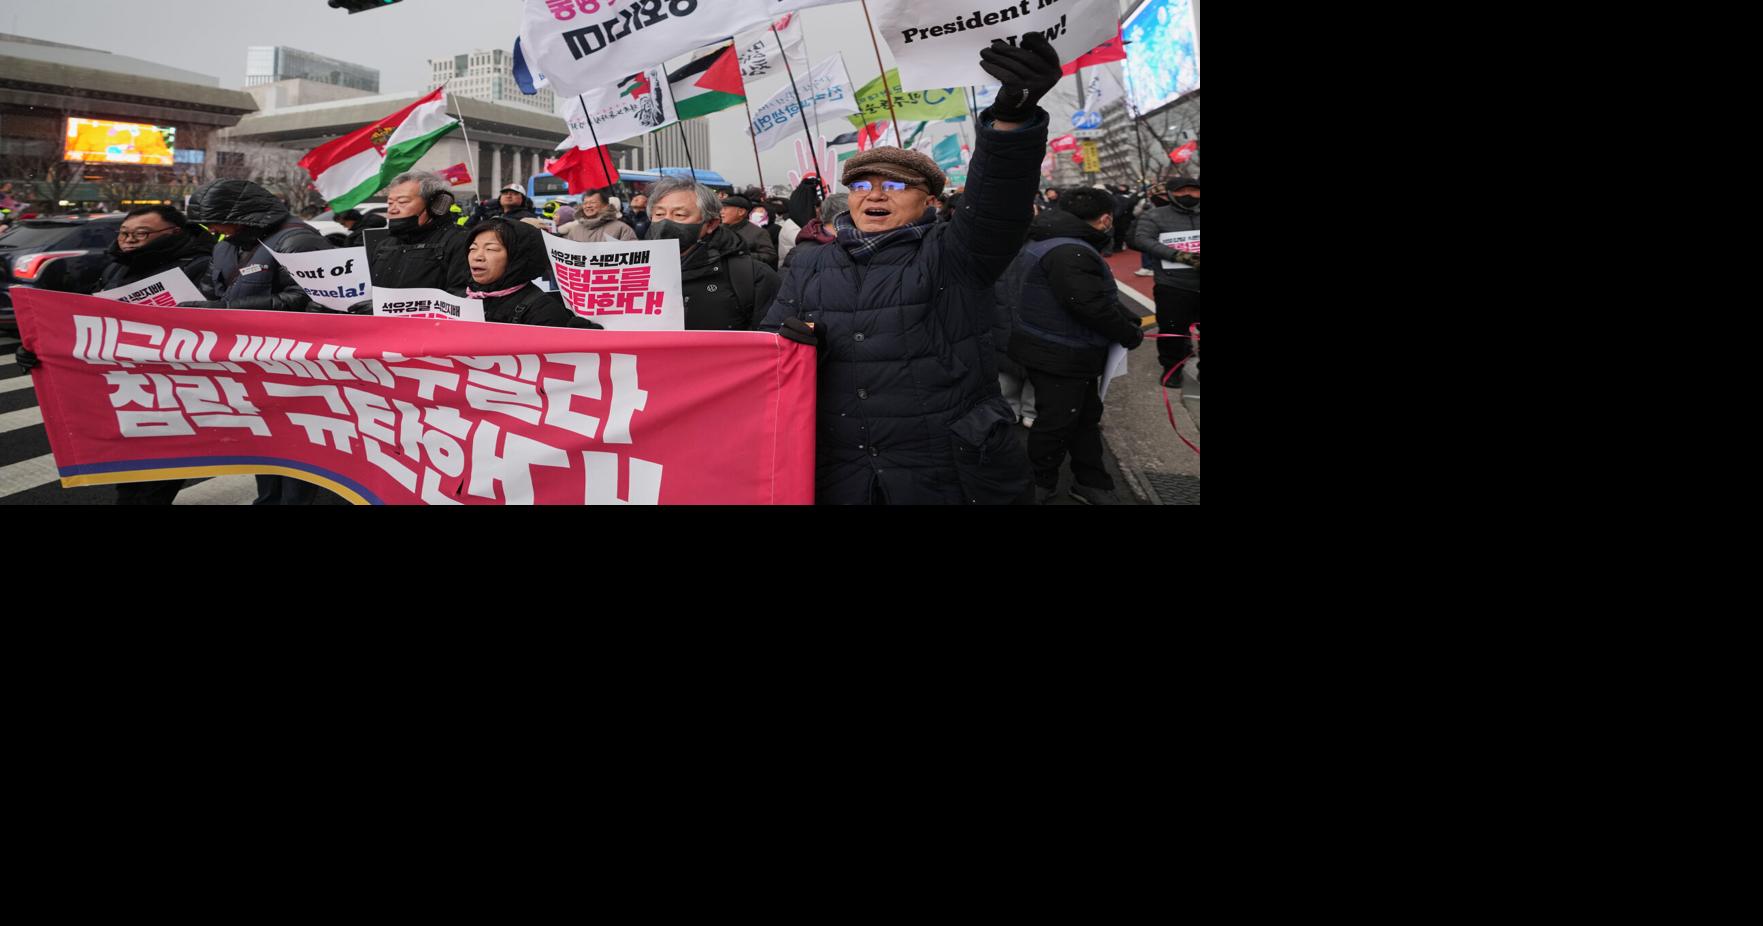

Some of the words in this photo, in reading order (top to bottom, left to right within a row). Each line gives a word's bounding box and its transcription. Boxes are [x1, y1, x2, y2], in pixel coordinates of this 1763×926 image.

[902, 0, 1030, 44] President
[296, 266, 325, 278] out
[331, 259, 354, 276] of
[551, 249, 588, 267] 석유강탈
[590, 249, 651, 267] 식민지배
[555, 262, 651, 292] 트럼프를
[382, 300, 432, 313] 석유강탈
[72, 315, 246, 373] 미국의
[102, 371, 272, 438] 침략
